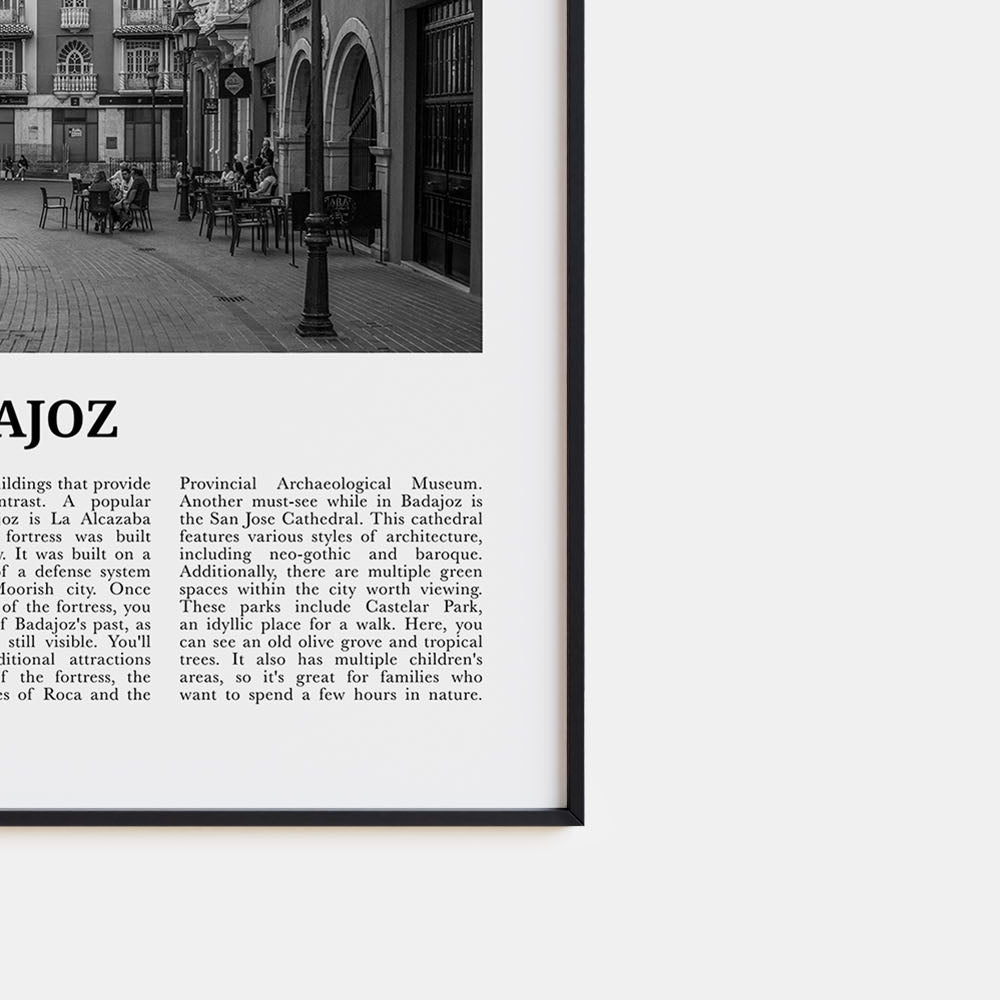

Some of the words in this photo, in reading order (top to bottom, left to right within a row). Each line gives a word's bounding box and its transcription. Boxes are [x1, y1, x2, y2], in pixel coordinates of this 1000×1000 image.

[58, 477, 88, 491] that
[93, 477, 151, 495] provide
[180, 477, 256, 491] Provincial
[277, 477, 391, 495] Archaeological
[412, 477, 482, 491] Museum.
[29, 513, 40, 526] is
[51, 512, 70, 526] La
[80, 512, 151, 526] Alcazaba
[180, 512, 203, 526] the
[210, 512, 238, 526] San
[242, 512, 275, 529] Jose
[282, 512, 363, 526] Cathedral.
[370, 512, 405, 526] This
[411, 512, 482, 526] cathedral
[16, 547, 27, 561] It
[35, 551, 63, 561] was
[72, 547, 106, 561] built
[115, 551, 133, 561] on
[142, 551, 151, 561] a
[180, 547, 252, 565] including
[270, 547, 350, 565] neo-gothic
[369, 547, 397, 561] and
[416, 547, 482, 565] baroque.
[18, 569, 26, 579] a
[35, 565, 91, 579] defense
[100, 567, 150, 583] system
[179, 565, 277, 583] Additionally,
[287, 565, 326, 579] there
[335, 569, 359, 579] are
[368, 565, 431, 583] multiple
[440, 569, 482, 583] green
[2, 600, 19, 614] of
[26, 600, 50, 614] the
[57, 600, 117, 616] fortress,
[123, 604, 150, 618] you
[179, 600, 226, 614] These
[240, 600, 281, 618] parks
[295, 600, 351, 614] include
[366, 600, 429, 614] Castelar
[444, 600, 482, 616] Park,
[180, 621, 198, 631] an
[207, 617, 253, 635] idyllic
[261, 617, 301, 635] place
[310, 617, 331, 631] for
[339, 621, 348, 631] a
[356, 617, 395, 631] walk.
[405, 617, 447, 633] Here,
[455, 621, 482, 635] you
[69, 653, 151, 666] attractions
[180, 654, 219, 666] trees.
[233, 652, 244, 666] It
[256, 652, 286, 666] also
[298, 652, 323, 666] has
[335, 652, 397, 670] multiple
[409, 652, 483, 666] children's
[18, 687, 35, 701] of
[44, 687, 82, 701] Roca
[90, 687, 119, 701] and
[127, 687, 151, 701] the
[179, 689, 216, 701] want
[226, 689, 240, 701] to
[249, 687, 293, 705] spend
[302, 691, 310, 701] a
[319, 687, 345, 701] few
[354, 687, 397, 701] hours
[405, 688, 420, 701] in
[429, 689, 482, 701] nature.
